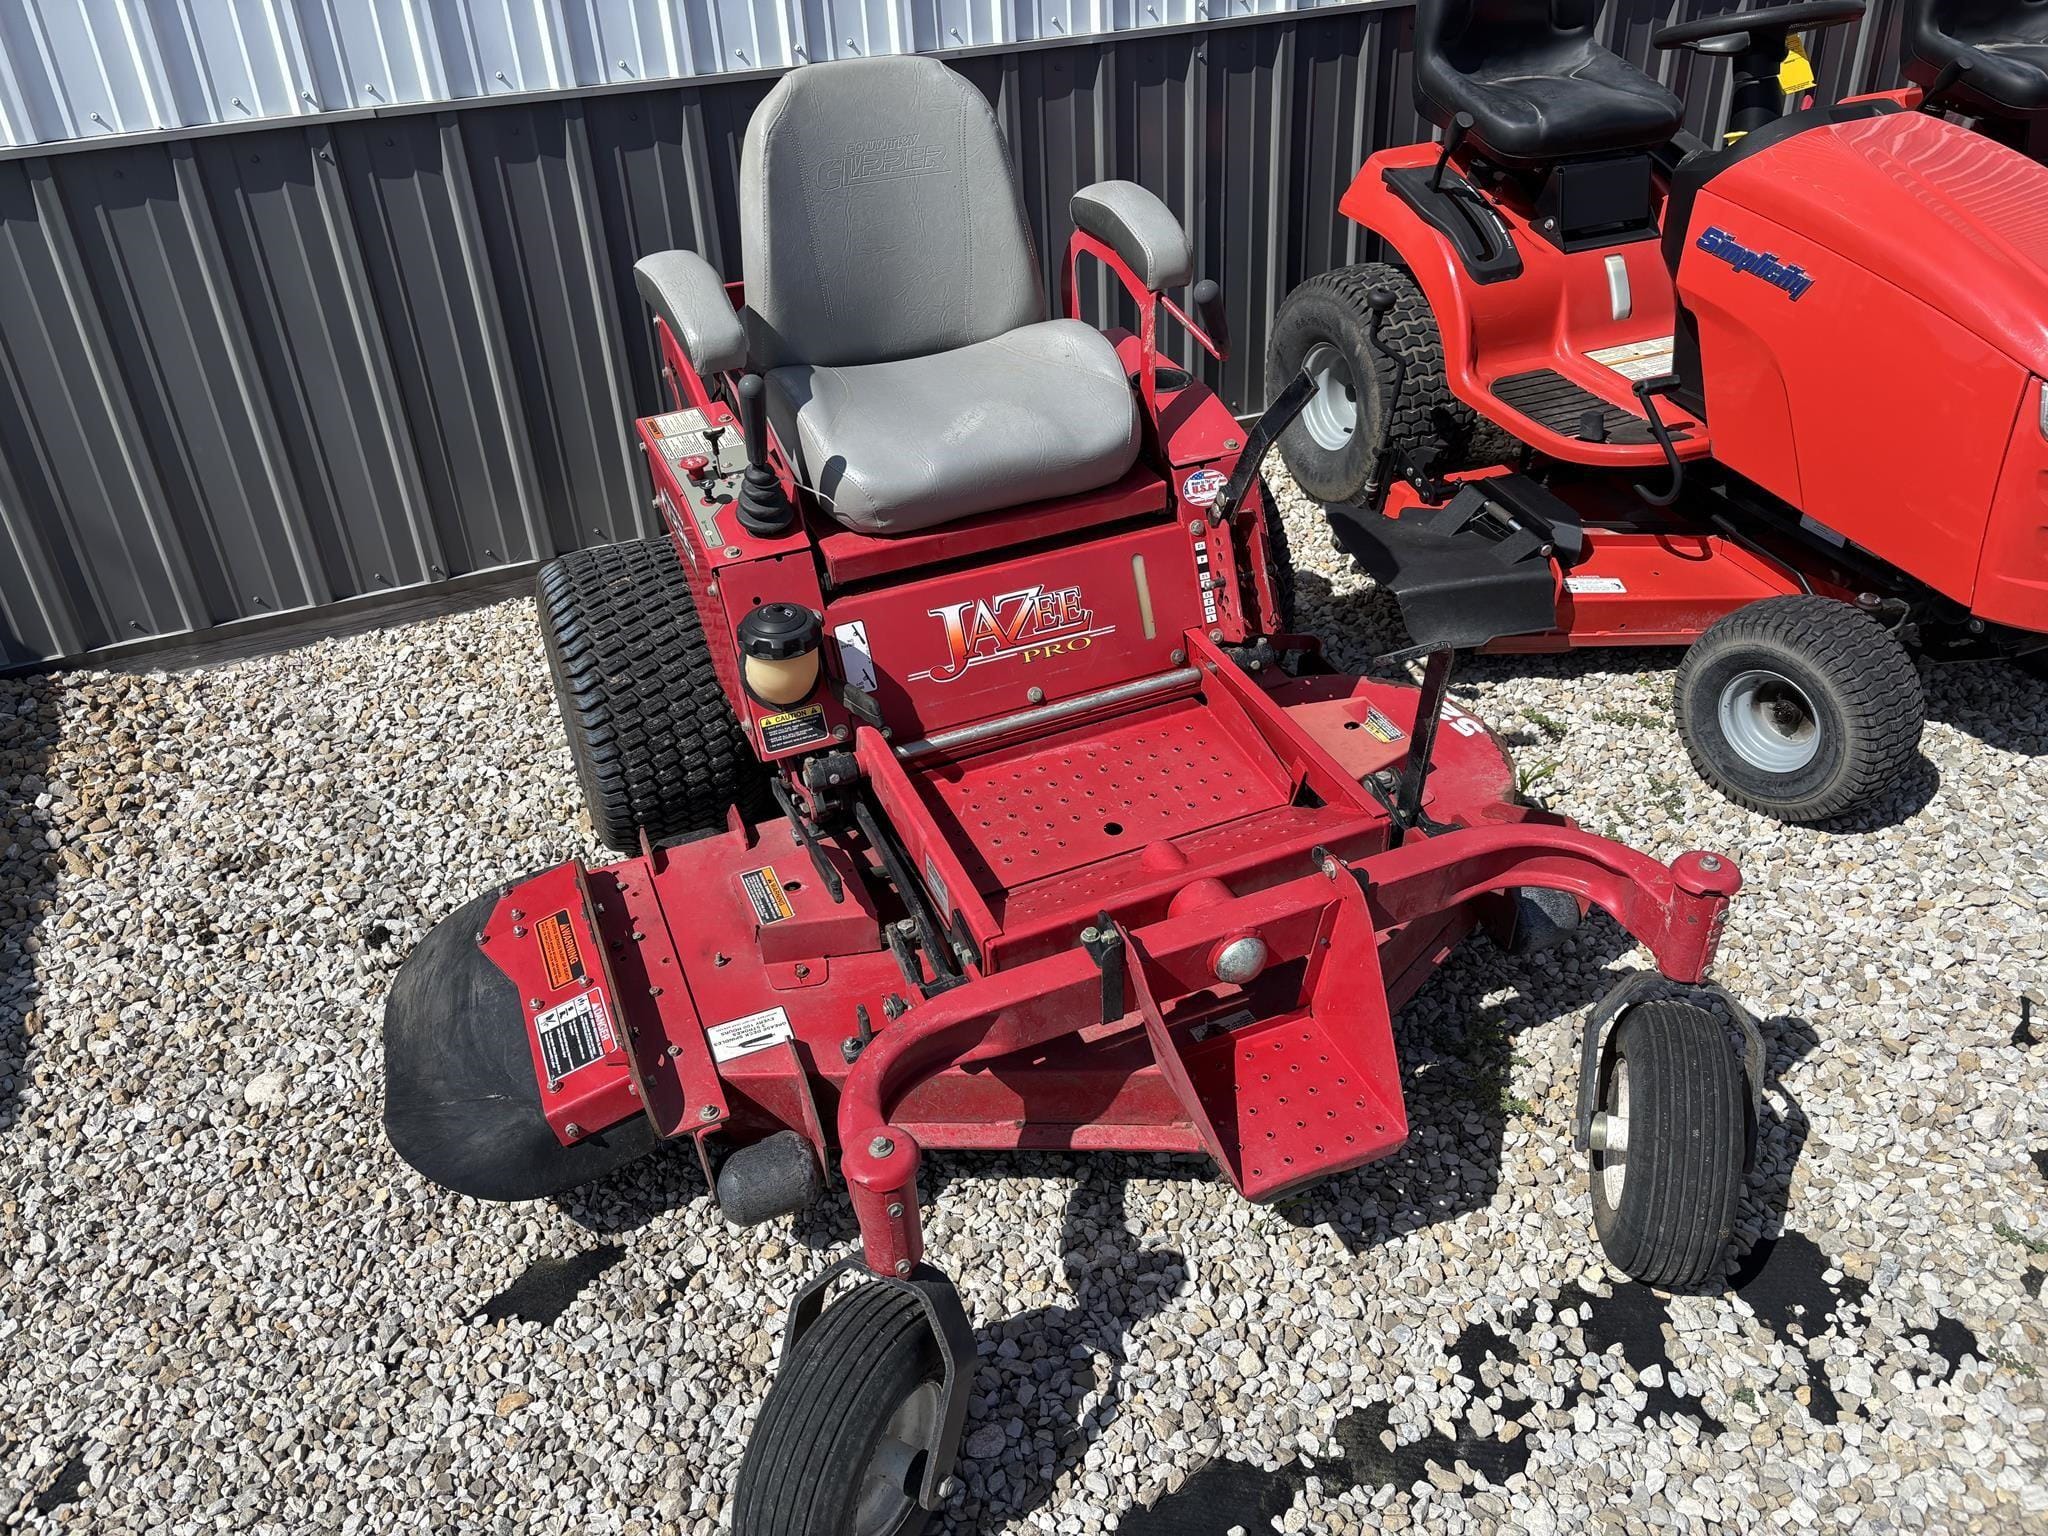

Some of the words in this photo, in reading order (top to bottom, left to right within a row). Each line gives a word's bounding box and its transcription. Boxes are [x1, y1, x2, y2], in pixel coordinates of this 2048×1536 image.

[844, 132, 920, 154] COUNTRY
[816, 143, 952, 191] CLIPPER
[1696, 226, 1815, 302] Simplicity
[927, 584, 1093, 682] JAZEE
[1022, 637, 1092, 664] PRO
[775, 710, 807, 722] CAUTION
[562, 926, 579, 964] WARNING
[594, 1007, 610, 1042] DANGER
